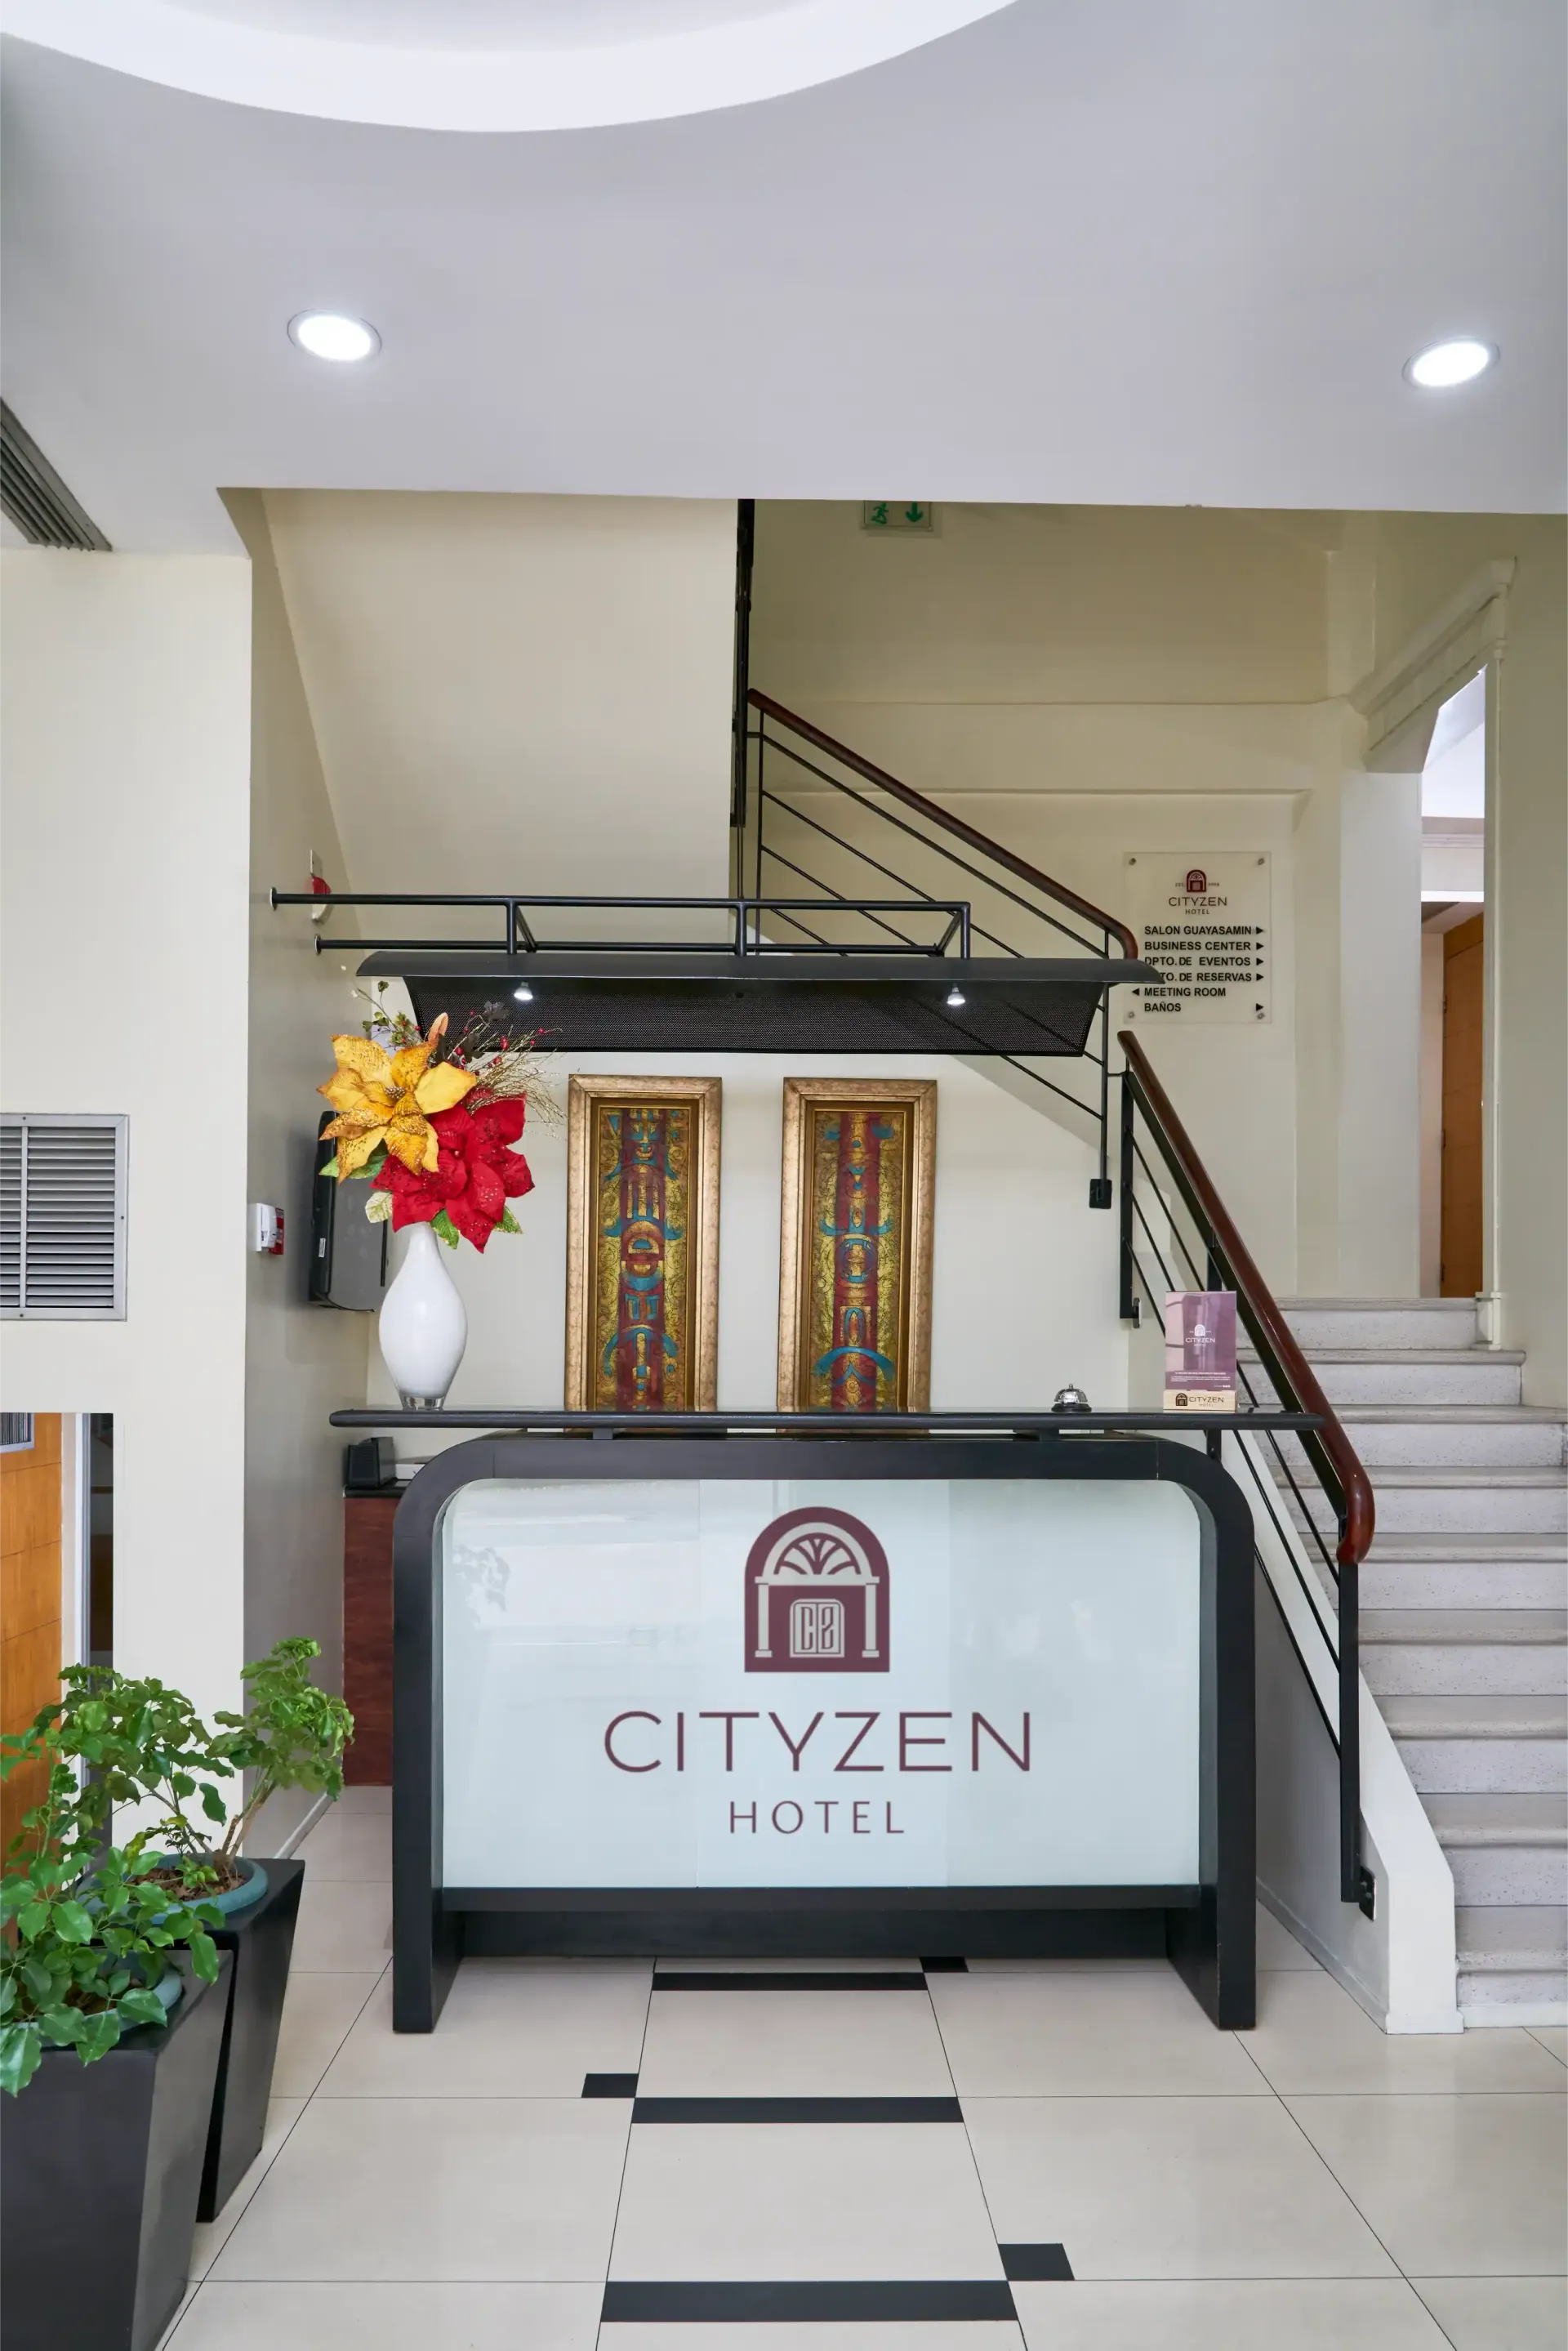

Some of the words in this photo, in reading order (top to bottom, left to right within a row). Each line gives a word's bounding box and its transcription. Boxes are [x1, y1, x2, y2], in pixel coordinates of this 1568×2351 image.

[1168, 896, 1227, 907] CITYZEN
[1144, 926, 1180, 935] SALON
[1183, 926, 1252, 935] GUAYASAMIN
[1144, 941, 1201, 951] BUSINESS
[1205, 941, 1251, 951] CENTER
[1199, 957, 1251, 966] EVENTOS
[1196, 972, 1252, 982] RESERVAS
[1144, 987, 1191, 997] MEETING
[1194, 987, 1226, 997] ROOM
[1144, 1002, 1182, 1012] BAÑOS
[604, 1711, 1031, 1773] CITYZEN
[730, 1800, 905, 1835] HOTEL
